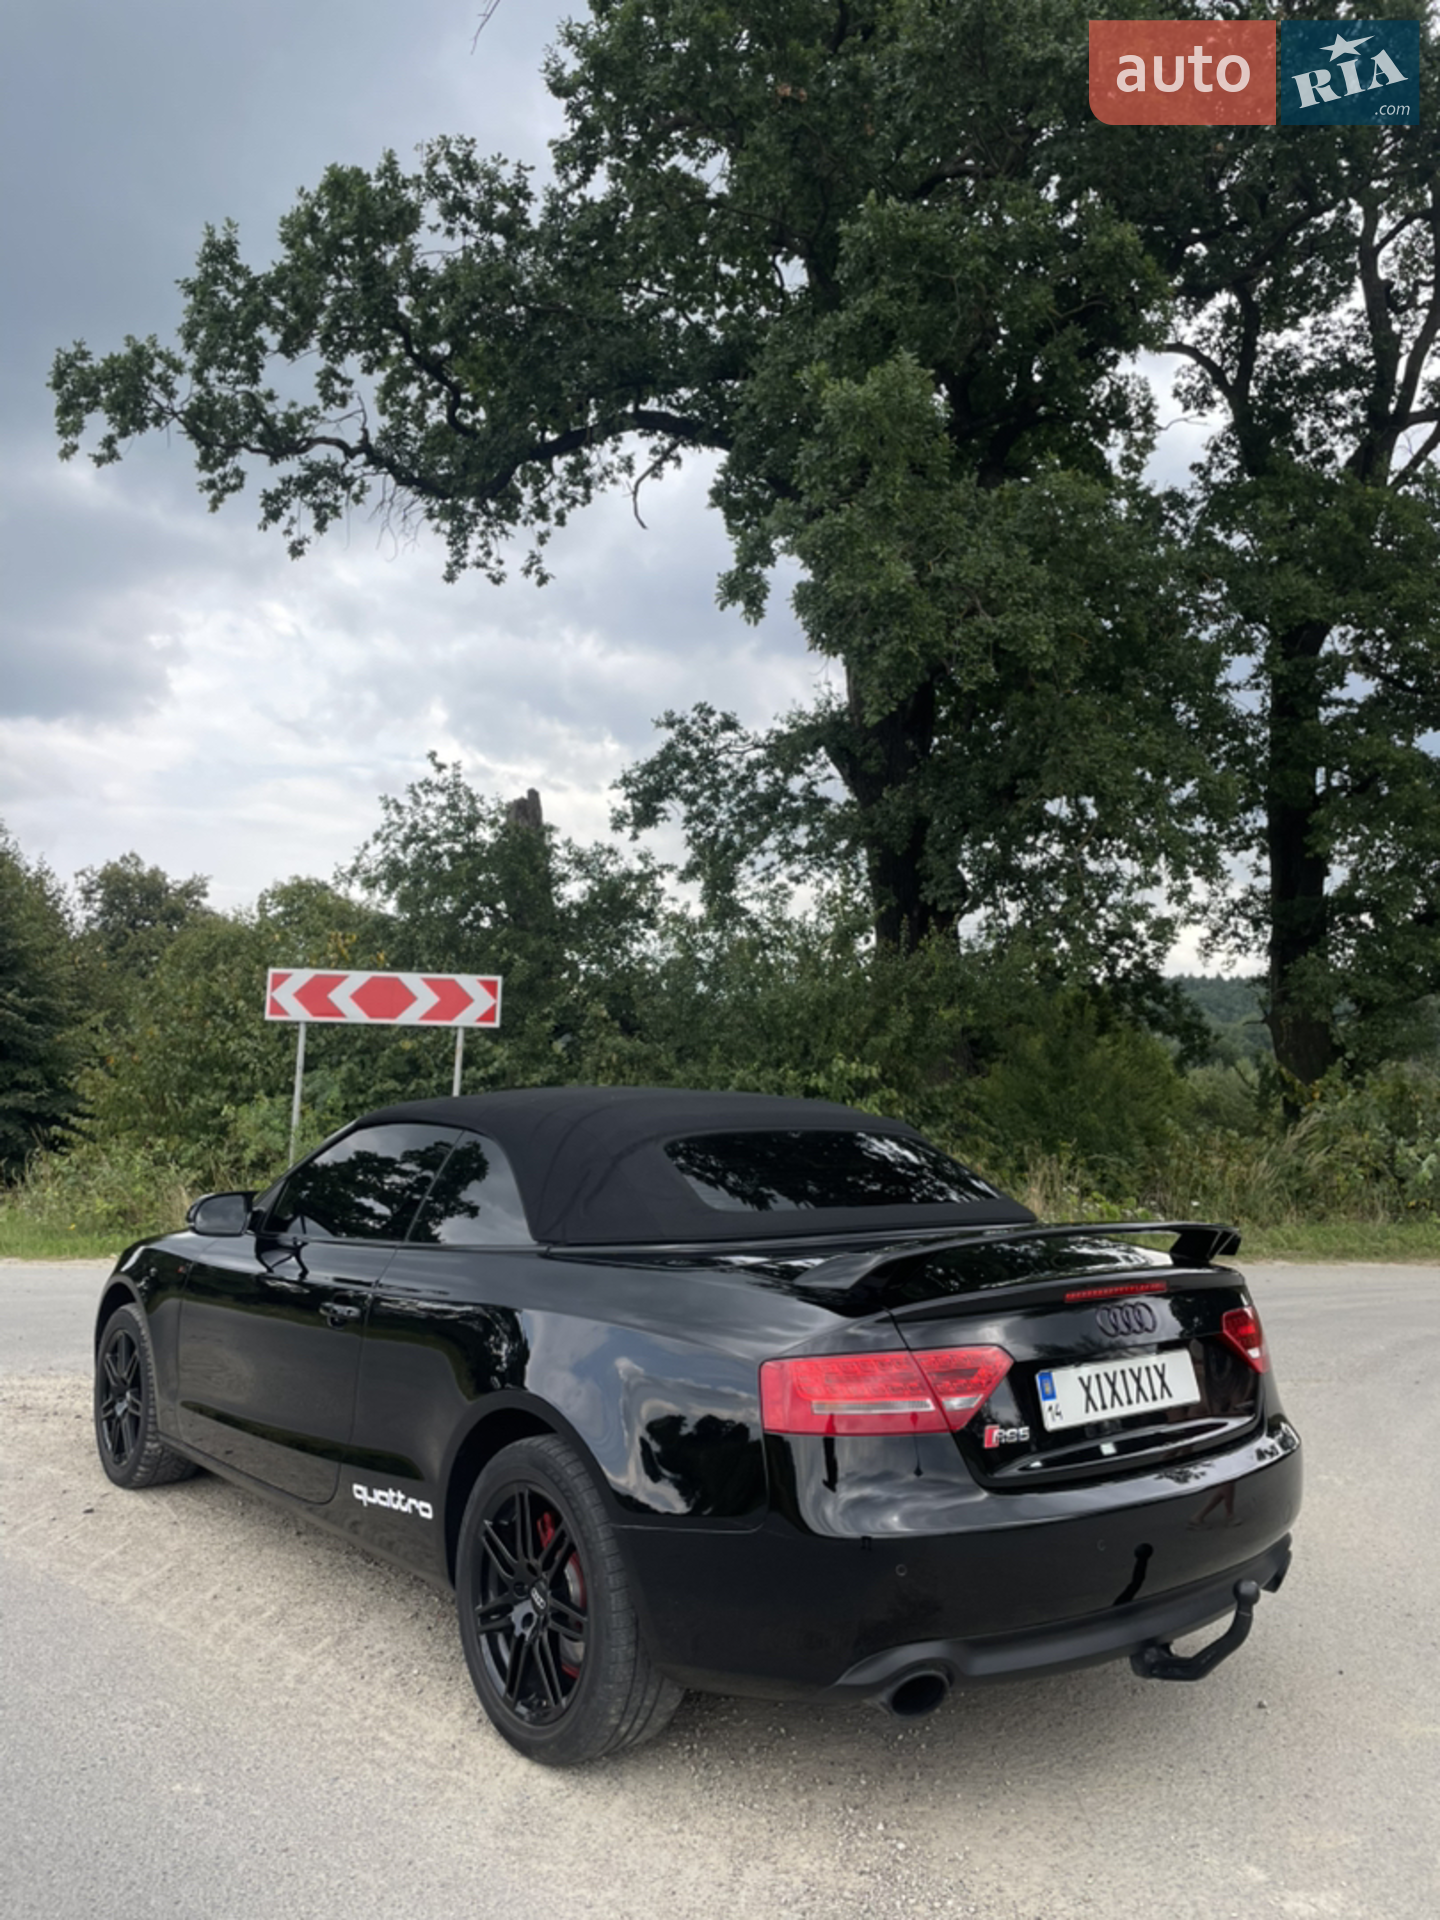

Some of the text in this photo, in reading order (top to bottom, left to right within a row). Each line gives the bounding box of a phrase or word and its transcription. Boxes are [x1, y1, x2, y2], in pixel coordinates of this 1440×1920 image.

[1077, 1362, 1174, 1414] XIXIXIX
[1046, 1402, 1064, 1422] 14
[352, 1483, 434, 1520] quattro
